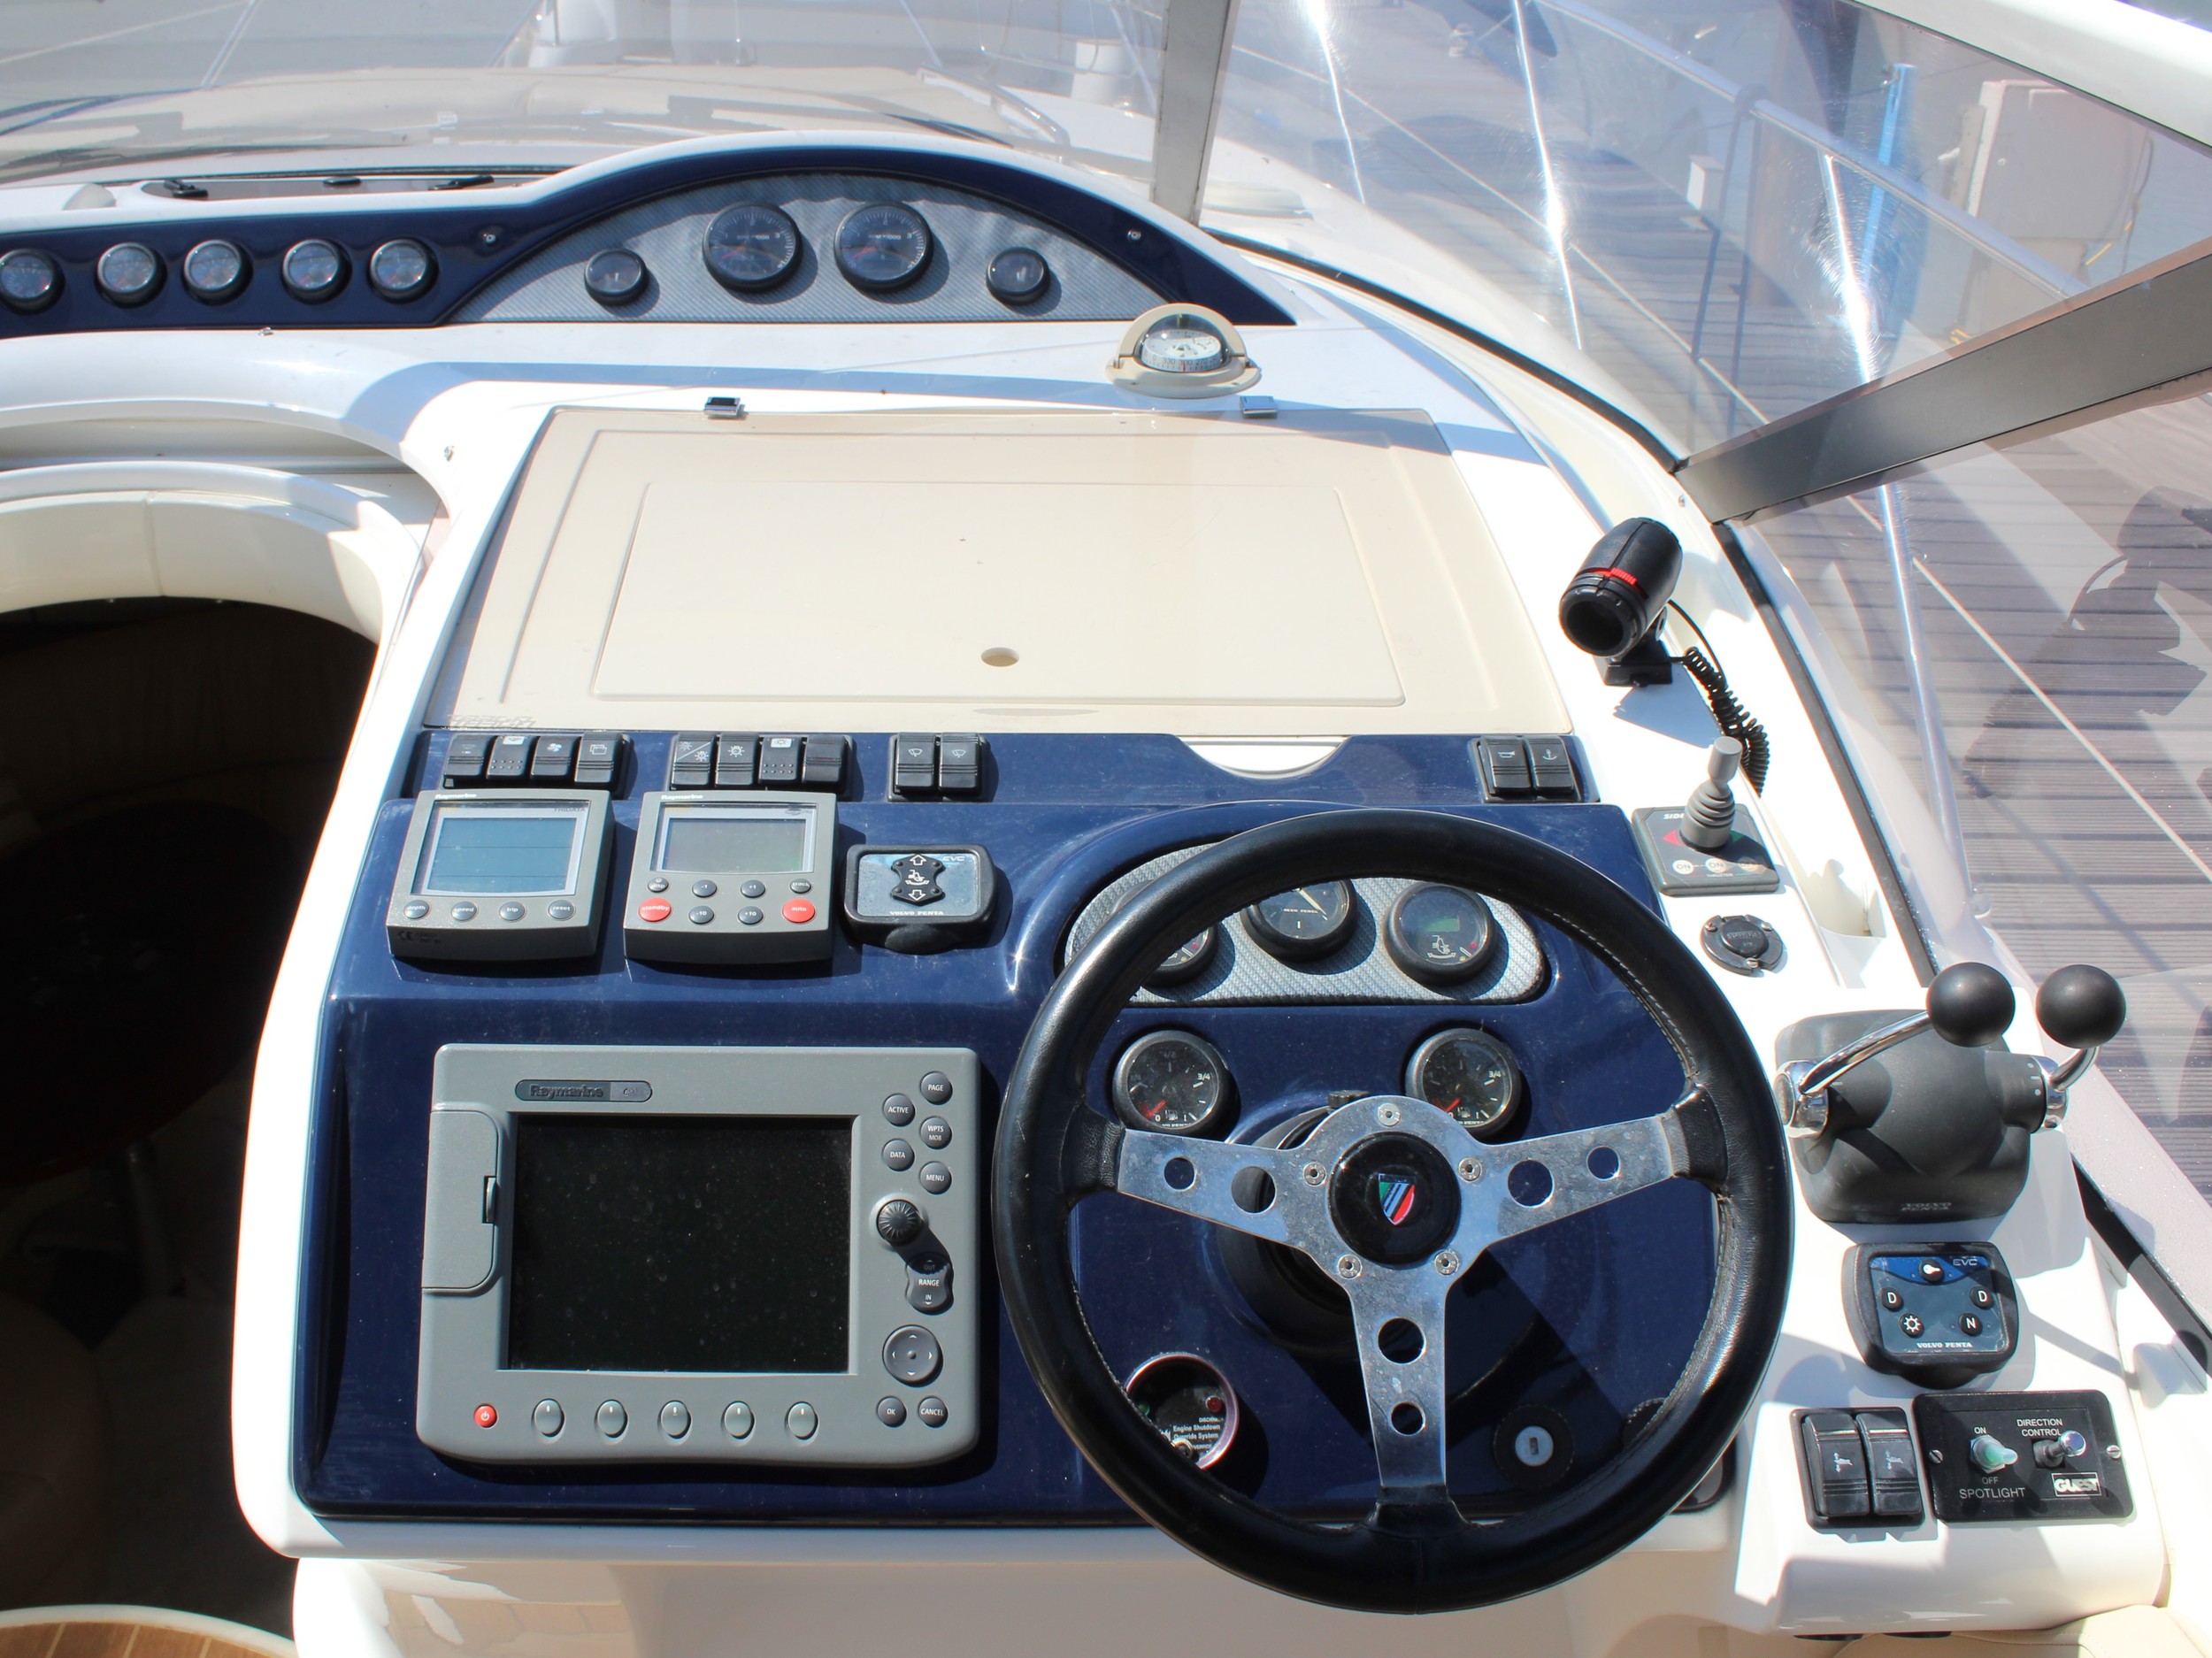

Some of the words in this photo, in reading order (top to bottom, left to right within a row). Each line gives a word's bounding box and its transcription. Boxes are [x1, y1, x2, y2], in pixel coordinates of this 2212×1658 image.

[530, 1084, 604, 1099] Raymarine
[1887, 1292, 1897, 1304] D
[1978, 1290, 1988, 1302] D
[1966, 1317, 1977, 1329] N
[920, 1408, 944, 1416] CANCEL
[2016, 1418, 2063, 1427] DIRECTION
[1198, 1432, 1219, 1440] System
[2022, 1428, 2062, 1437] CONTROL
[2054, 1478, 2101, 1493] GUEST
[1959, 1487, 2026, 1499] SPOTLIGHT
